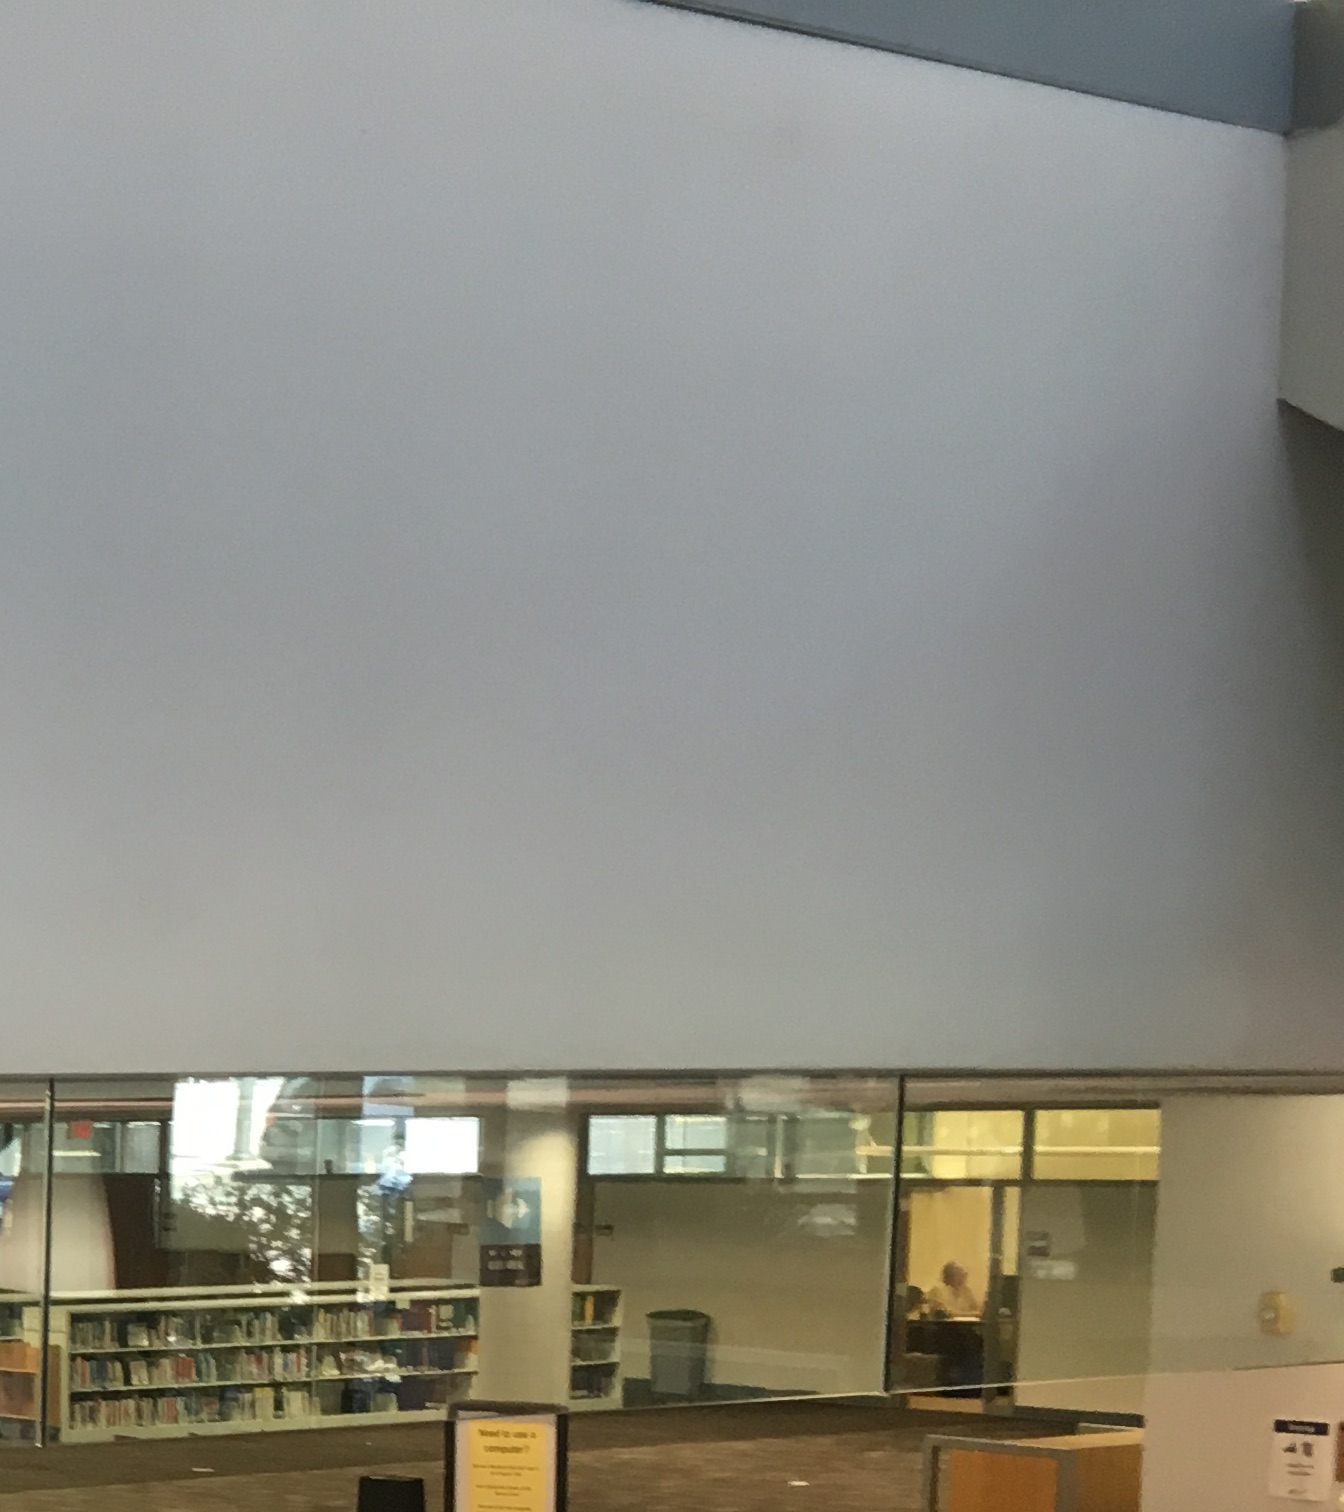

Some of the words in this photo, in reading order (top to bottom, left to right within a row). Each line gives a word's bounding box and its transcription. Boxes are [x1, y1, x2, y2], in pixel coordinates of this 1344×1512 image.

[478, 1429, 500, 1438] Need
[501, 1430, 510, 1438] to
[513, 1431, 528, 1439] use
[483, 1445, 530, 1454] computer?
